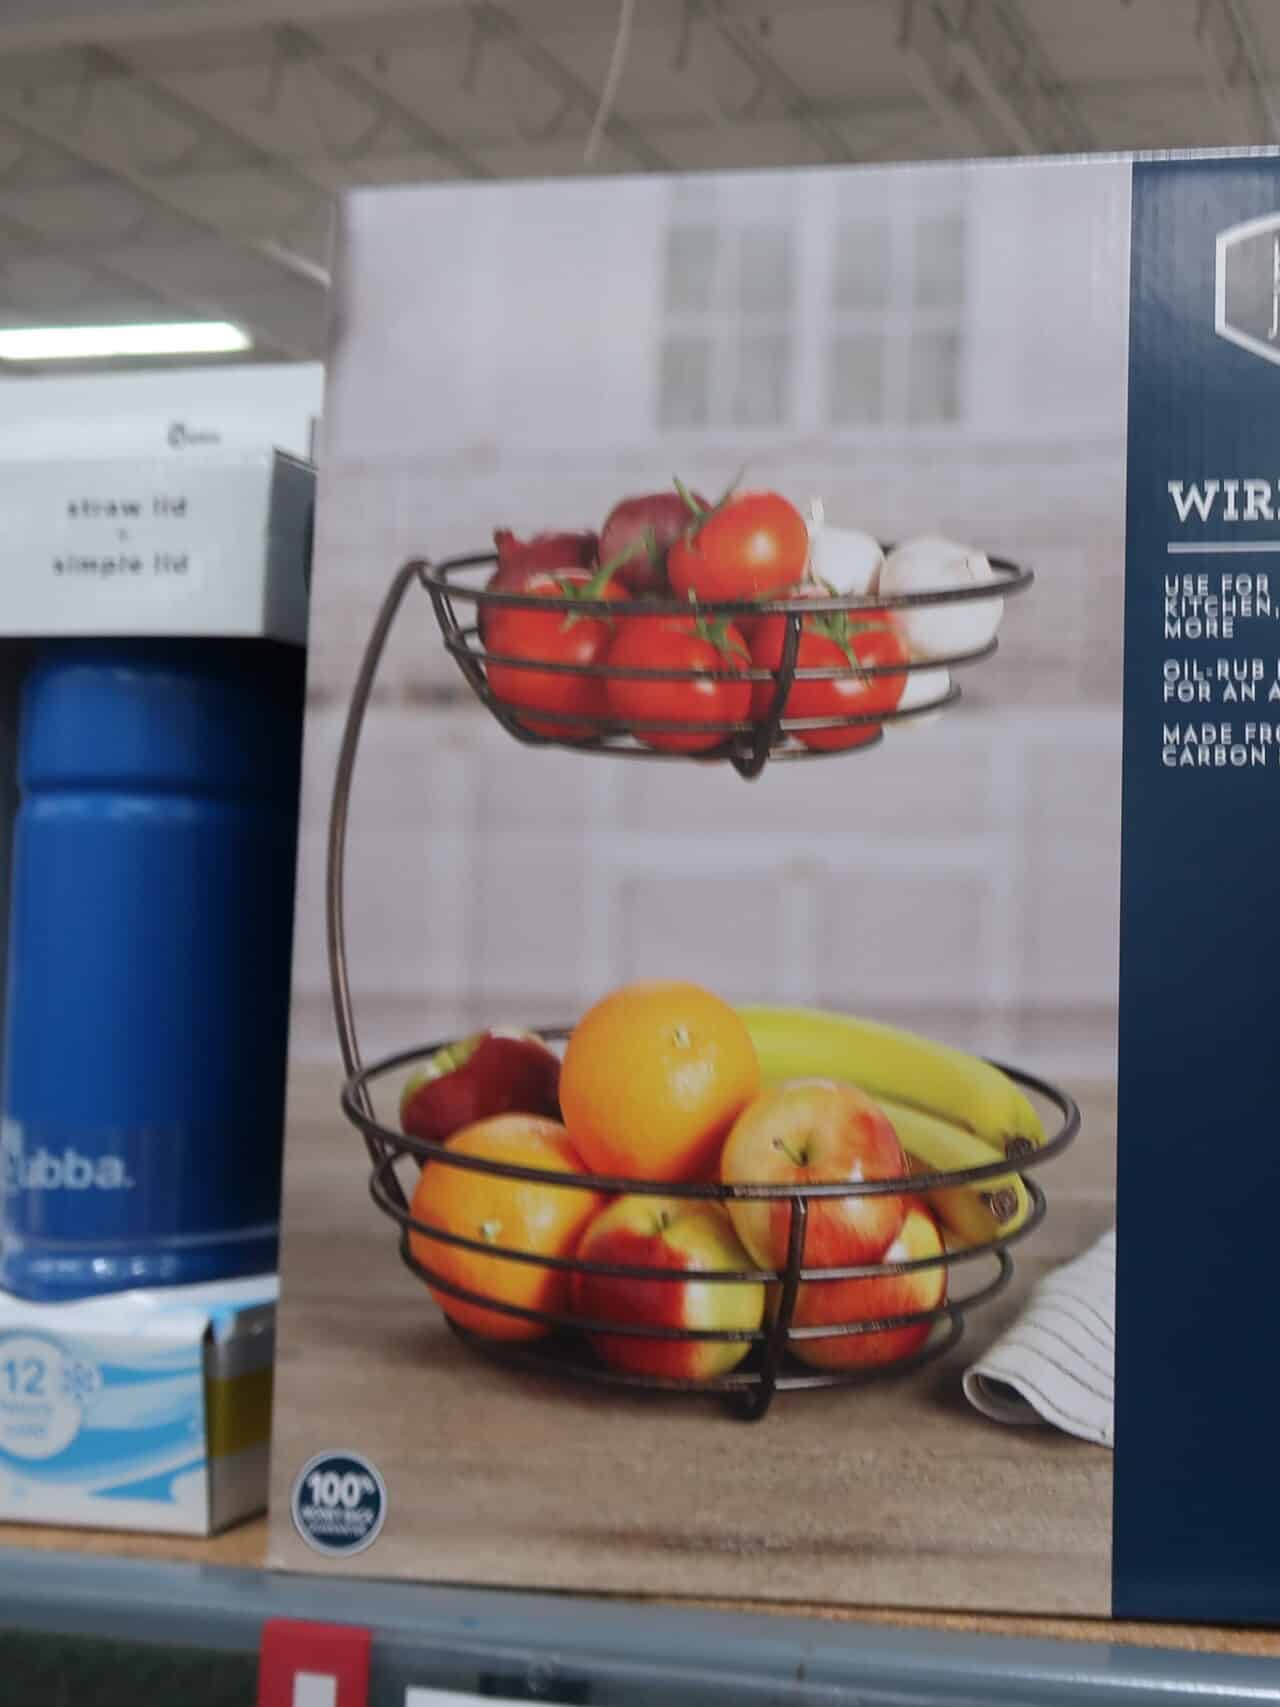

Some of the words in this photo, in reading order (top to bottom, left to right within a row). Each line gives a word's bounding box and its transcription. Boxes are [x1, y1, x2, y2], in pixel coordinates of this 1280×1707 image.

[67, 498, 141, 518] straw
[152, 496, 188, 518] lid
[53, 554, 142, 579] simple
[153, 553, 188, 575] lid
[1164, 573, 1210, 597] USE
[1221, 573, 1270, 596] FOR
[1164, 595, 1280, 619] KITCHEN,
[1164, 616, 1235, 640] MORE
[1163, 658, 1265, 682] OIL-RUB
[1163, 681, 1212, 703] FOR
[1222, 680, 1257, 703] AN
[1162, 722, 1232, 746] MADE
[1161, 744, 1266, 767] CARBON
